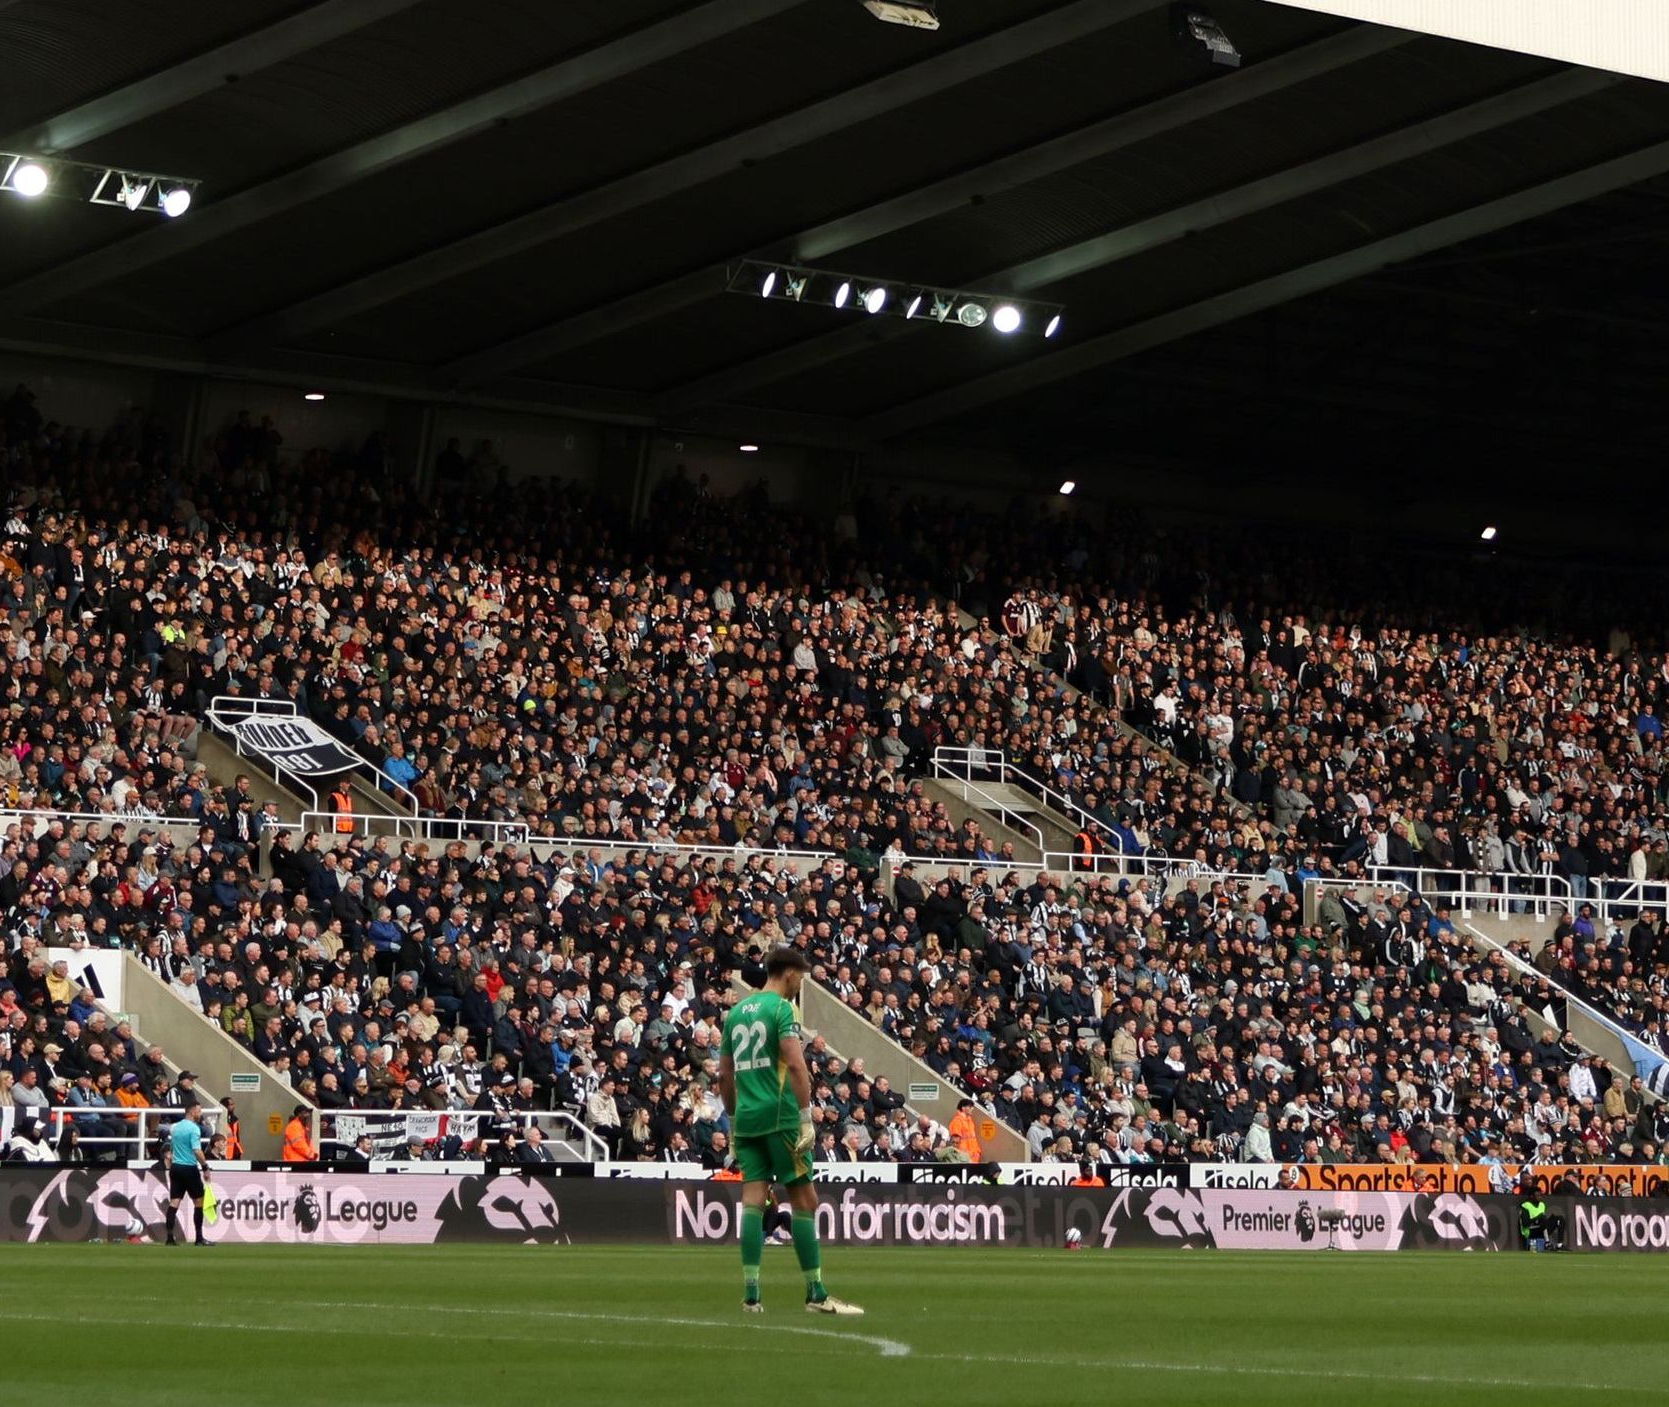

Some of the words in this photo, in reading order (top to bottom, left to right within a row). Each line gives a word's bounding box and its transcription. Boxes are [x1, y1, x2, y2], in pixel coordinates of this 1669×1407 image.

[731, 1020, 771, 1072] 22
[217, 1193, 289, 1220] remier
[326, 1195, 418, 1231] League
[676, 1188, 729, 1240] No
[840, 1186, 893, 1240] for
[894, 1188, 1005, 1240] racism
[1222, 1204, 1290, 1231] Premier
[1318, 1205, 1385, 1239] League
[1575, 1203, 1615, 1248] No
